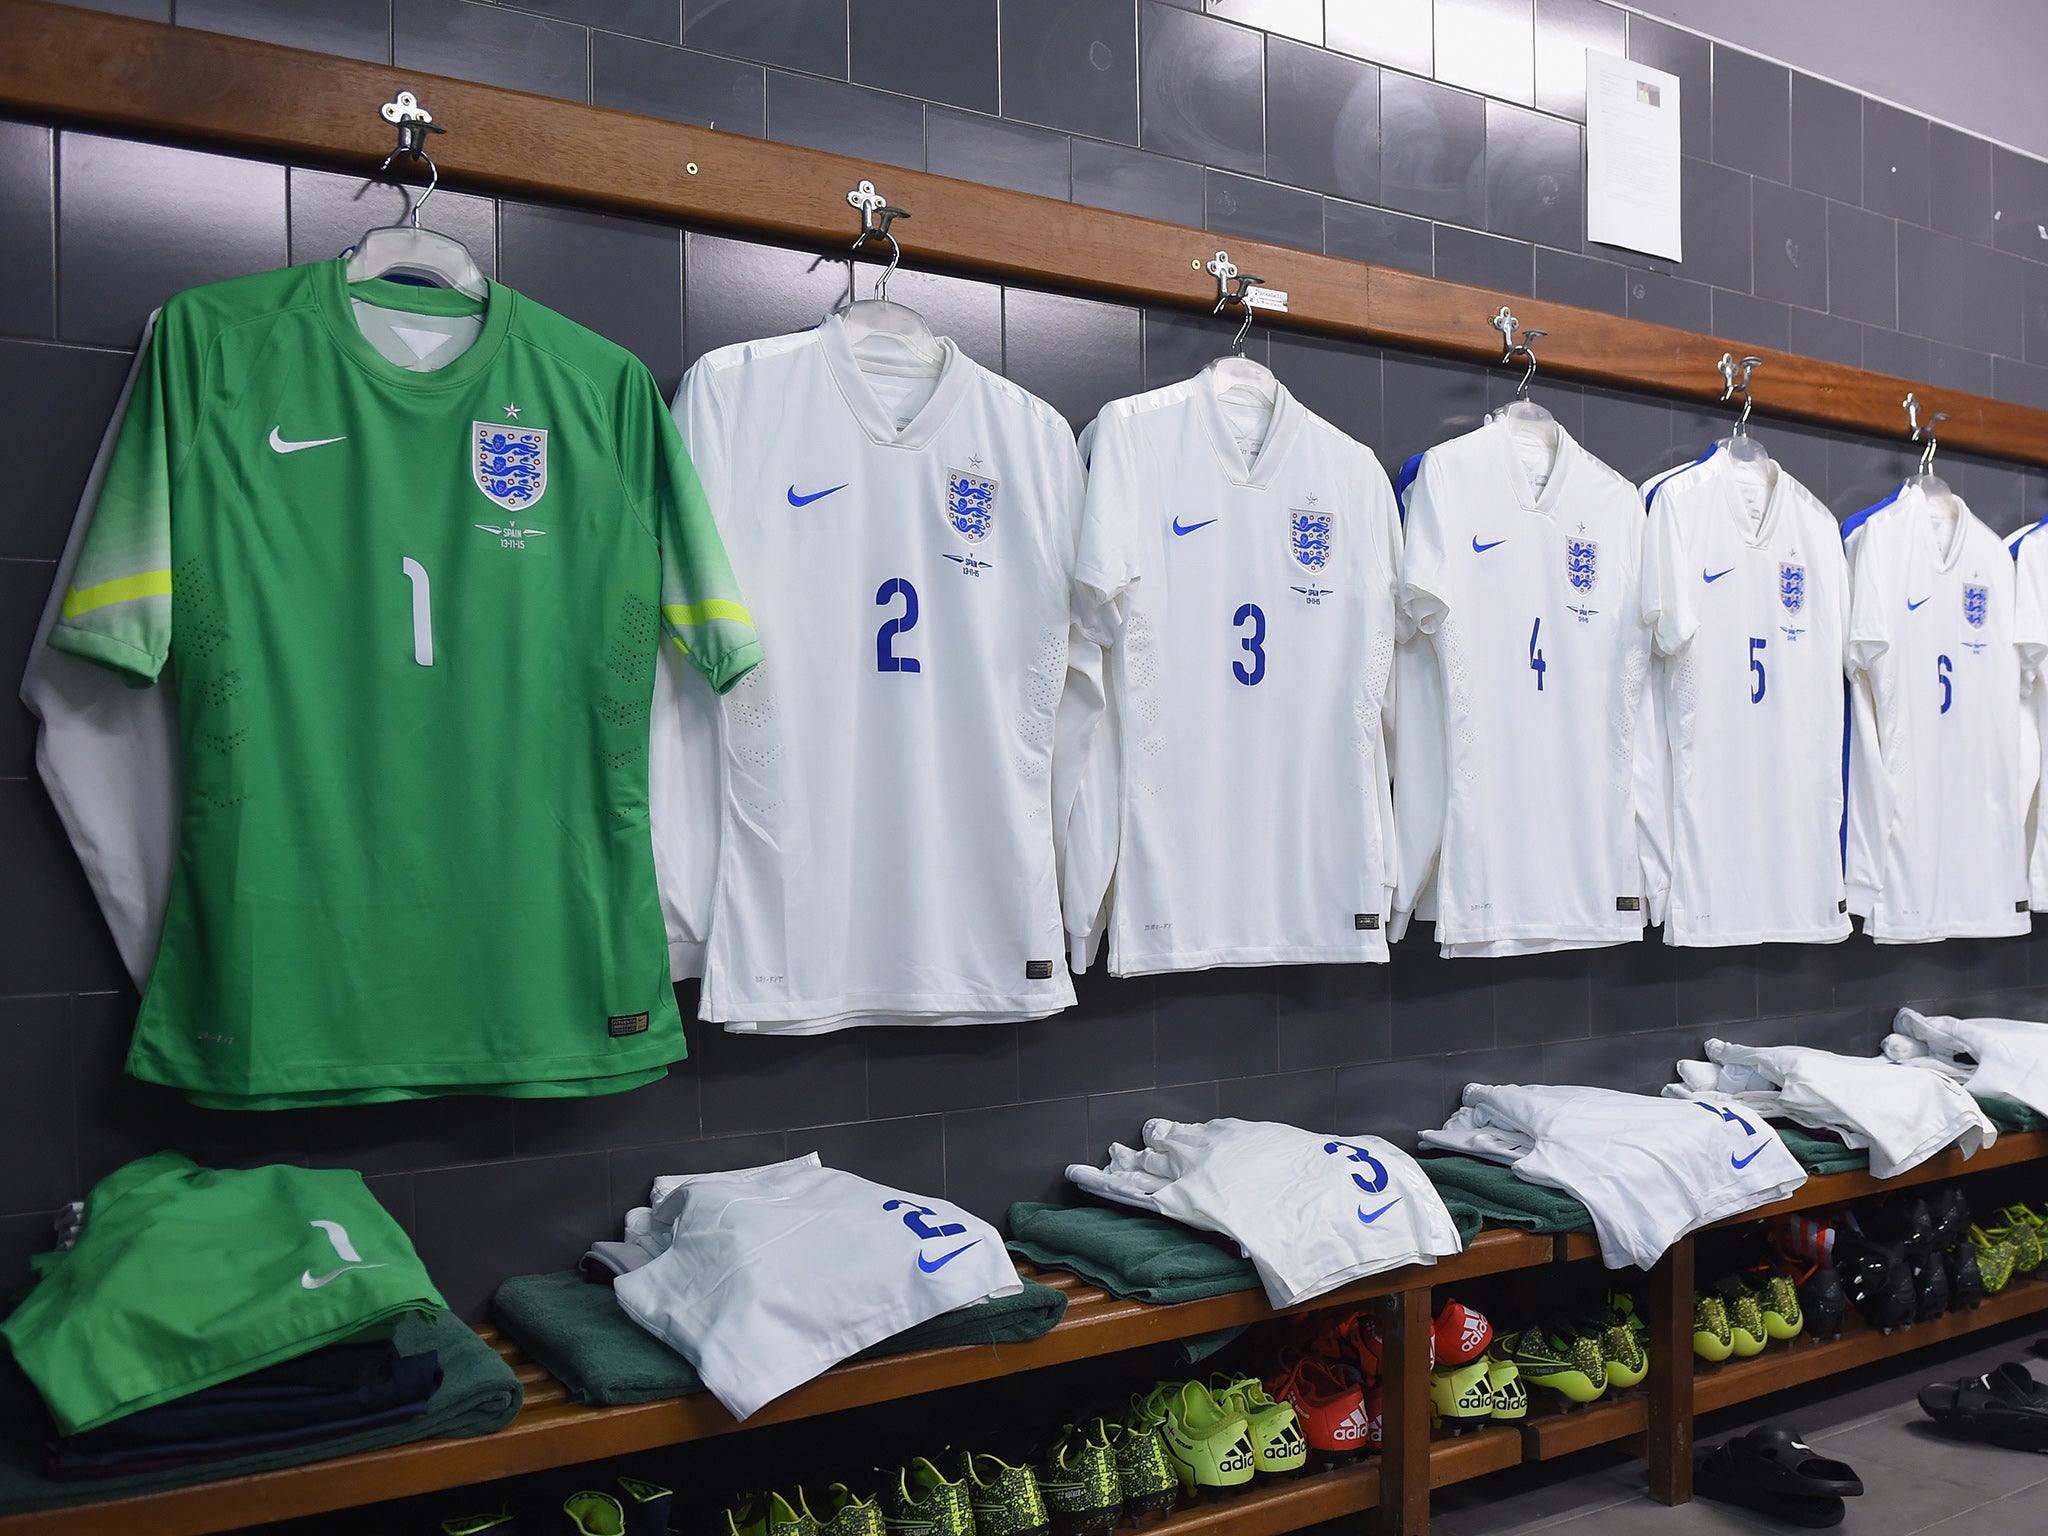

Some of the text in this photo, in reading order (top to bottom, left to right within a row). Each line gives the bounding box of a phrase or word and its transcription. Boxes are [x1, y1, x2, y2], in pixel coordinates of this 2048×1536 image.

[503, 528, 522, 538] SPAIN
[402, 556, 434, 667] 1
[875, 577, 921, 674] 2
[1232, 602, 1267, 687] 3
[1529, 616, 1547, 692] 4
[1748, 636, 1767, 705] 5
[1937, 654, 1953, 715] 6
[1323, 1141, 1389, 1194] 3
[310, 1220, 362, 1262] 1
[882, 1199, 968, 1240] 2
